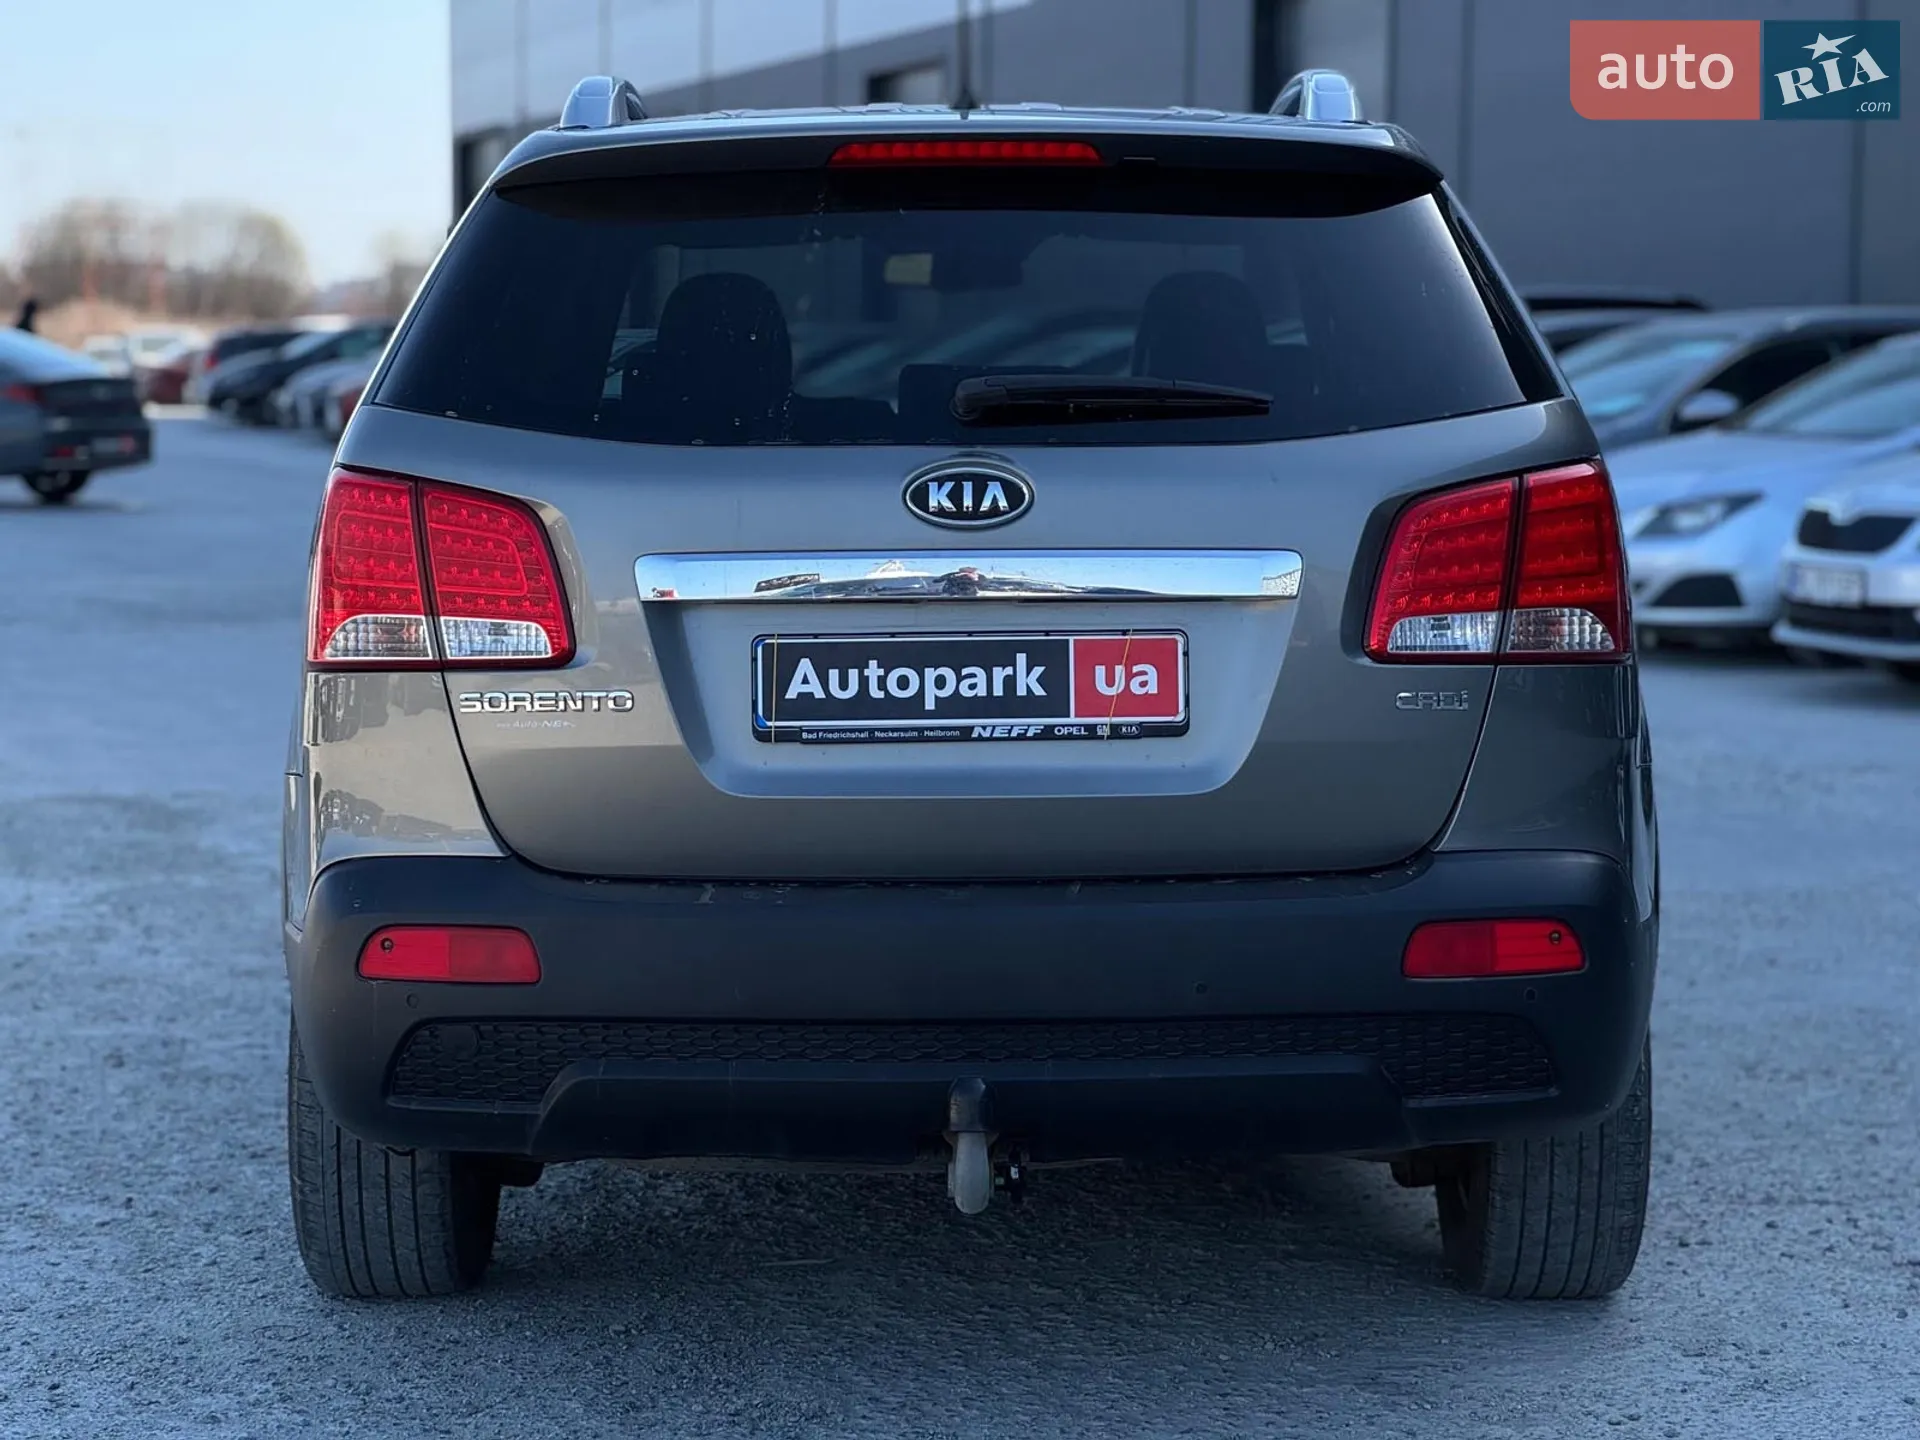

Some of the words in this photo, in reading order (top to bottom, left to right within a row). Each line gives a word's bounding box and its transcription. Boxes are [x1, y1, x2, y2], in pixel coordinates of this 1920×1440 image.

[927, 481, 1010, 513] KIA
[785, 653, 1048, 710] Autopark
[1094, 662, 1159, 695] ua
[459, 691, 634, 713] SORENTO
[874, 730, 918, 738] Neckarsulm
[924, 729, 960, 737] Heilbronn
[971, 725, 1045, 738] NEFF
[1054, 726, 1088, 736] OPEL
[1121, 725, 1138, 735] KIA
